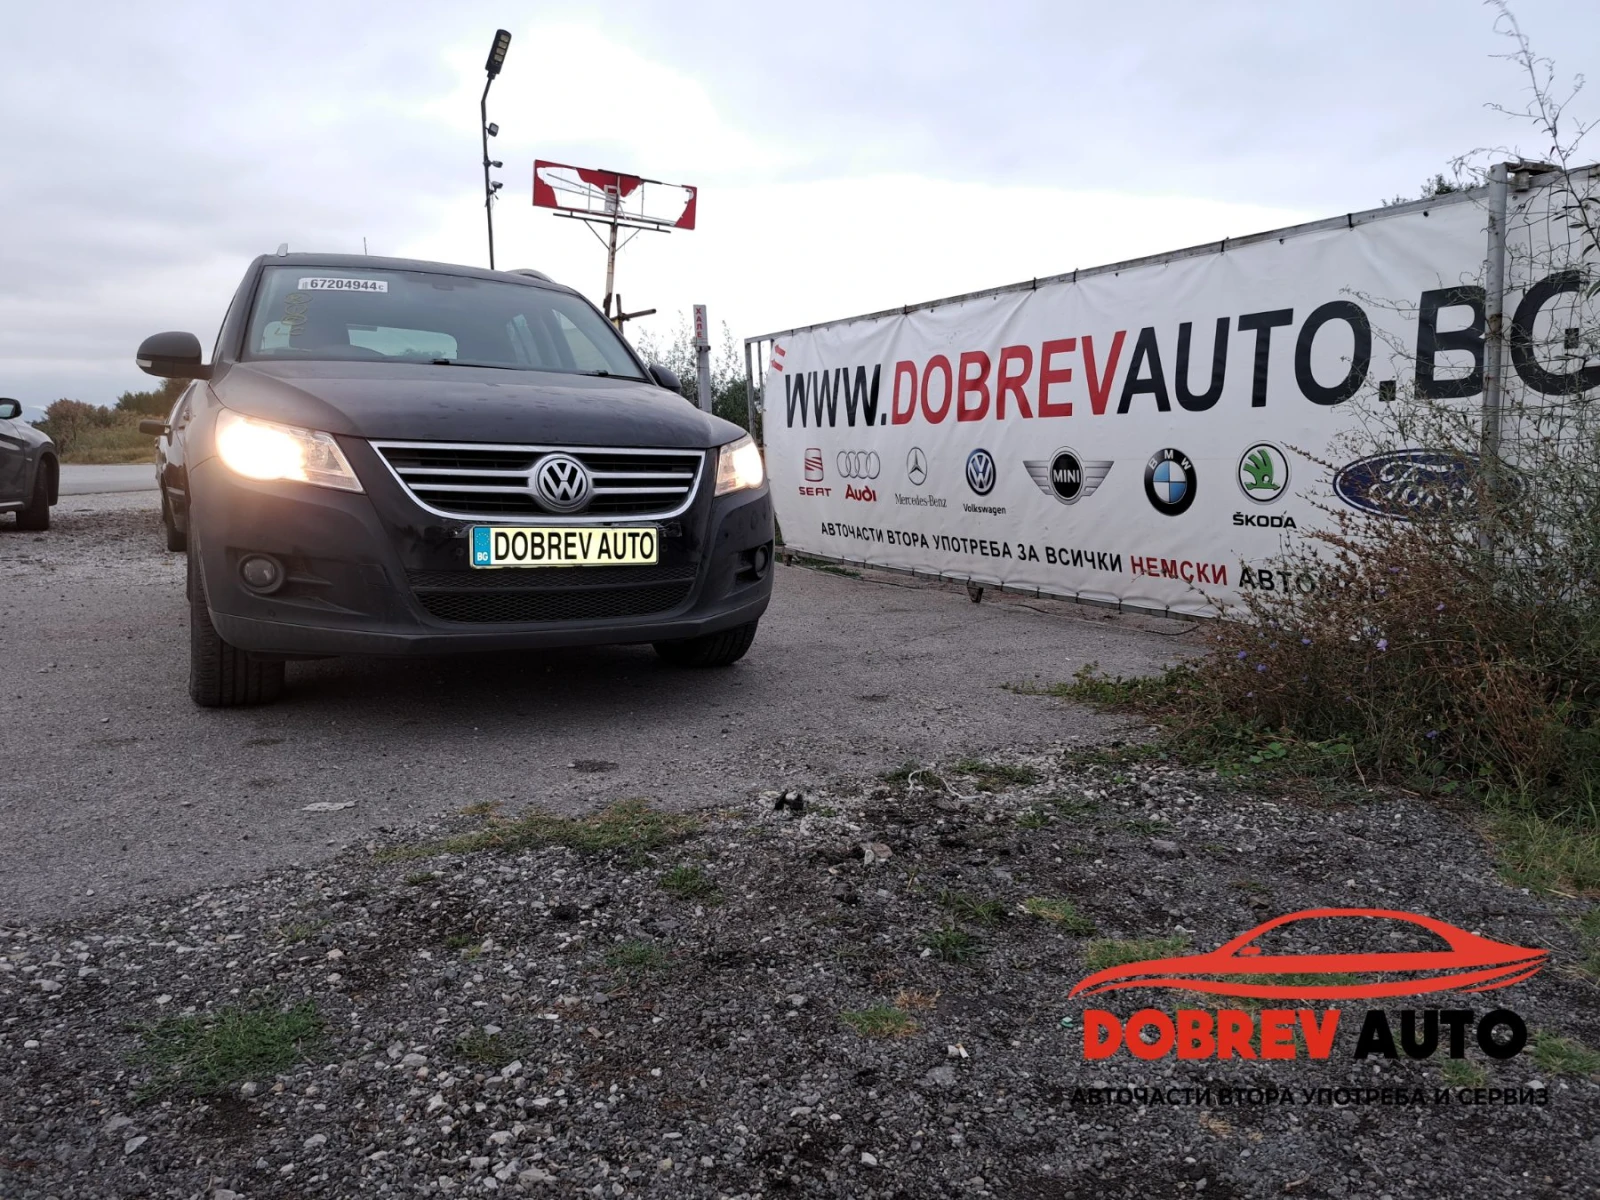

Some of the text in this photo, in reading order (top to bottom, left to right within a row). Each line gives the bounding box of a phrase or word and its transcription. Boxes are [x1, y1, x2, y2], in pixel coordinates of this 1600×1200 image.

[1149, 449, 1192, 470] BMW
[1053, 468, 1081, 484] MINI
[798, 486, 832, 497] SEAT
[845, 484, 877, 502] Audi
[895, 493, 947, 508] Mercedes-Benz
[963, 503, 1006, 516] Volkswagen
[1233, 511, 1297, 528] ŠKODA
[494, 531, 654, 561] DOBREV AUTO
[821, 522, 884, 543] АВТОЧАСТИ
[887, 530, 929, 549] ВТОРА
[932, 534, 1012, 559] УПОТРЕБА
[1017, 543, 1040, 562] ЗА
[1045, 546, 1123, 573] ВСИЧКИ
[1130, 555, 1228, 586] НЕМСКИ
[477, 551, 488, 561] BG
